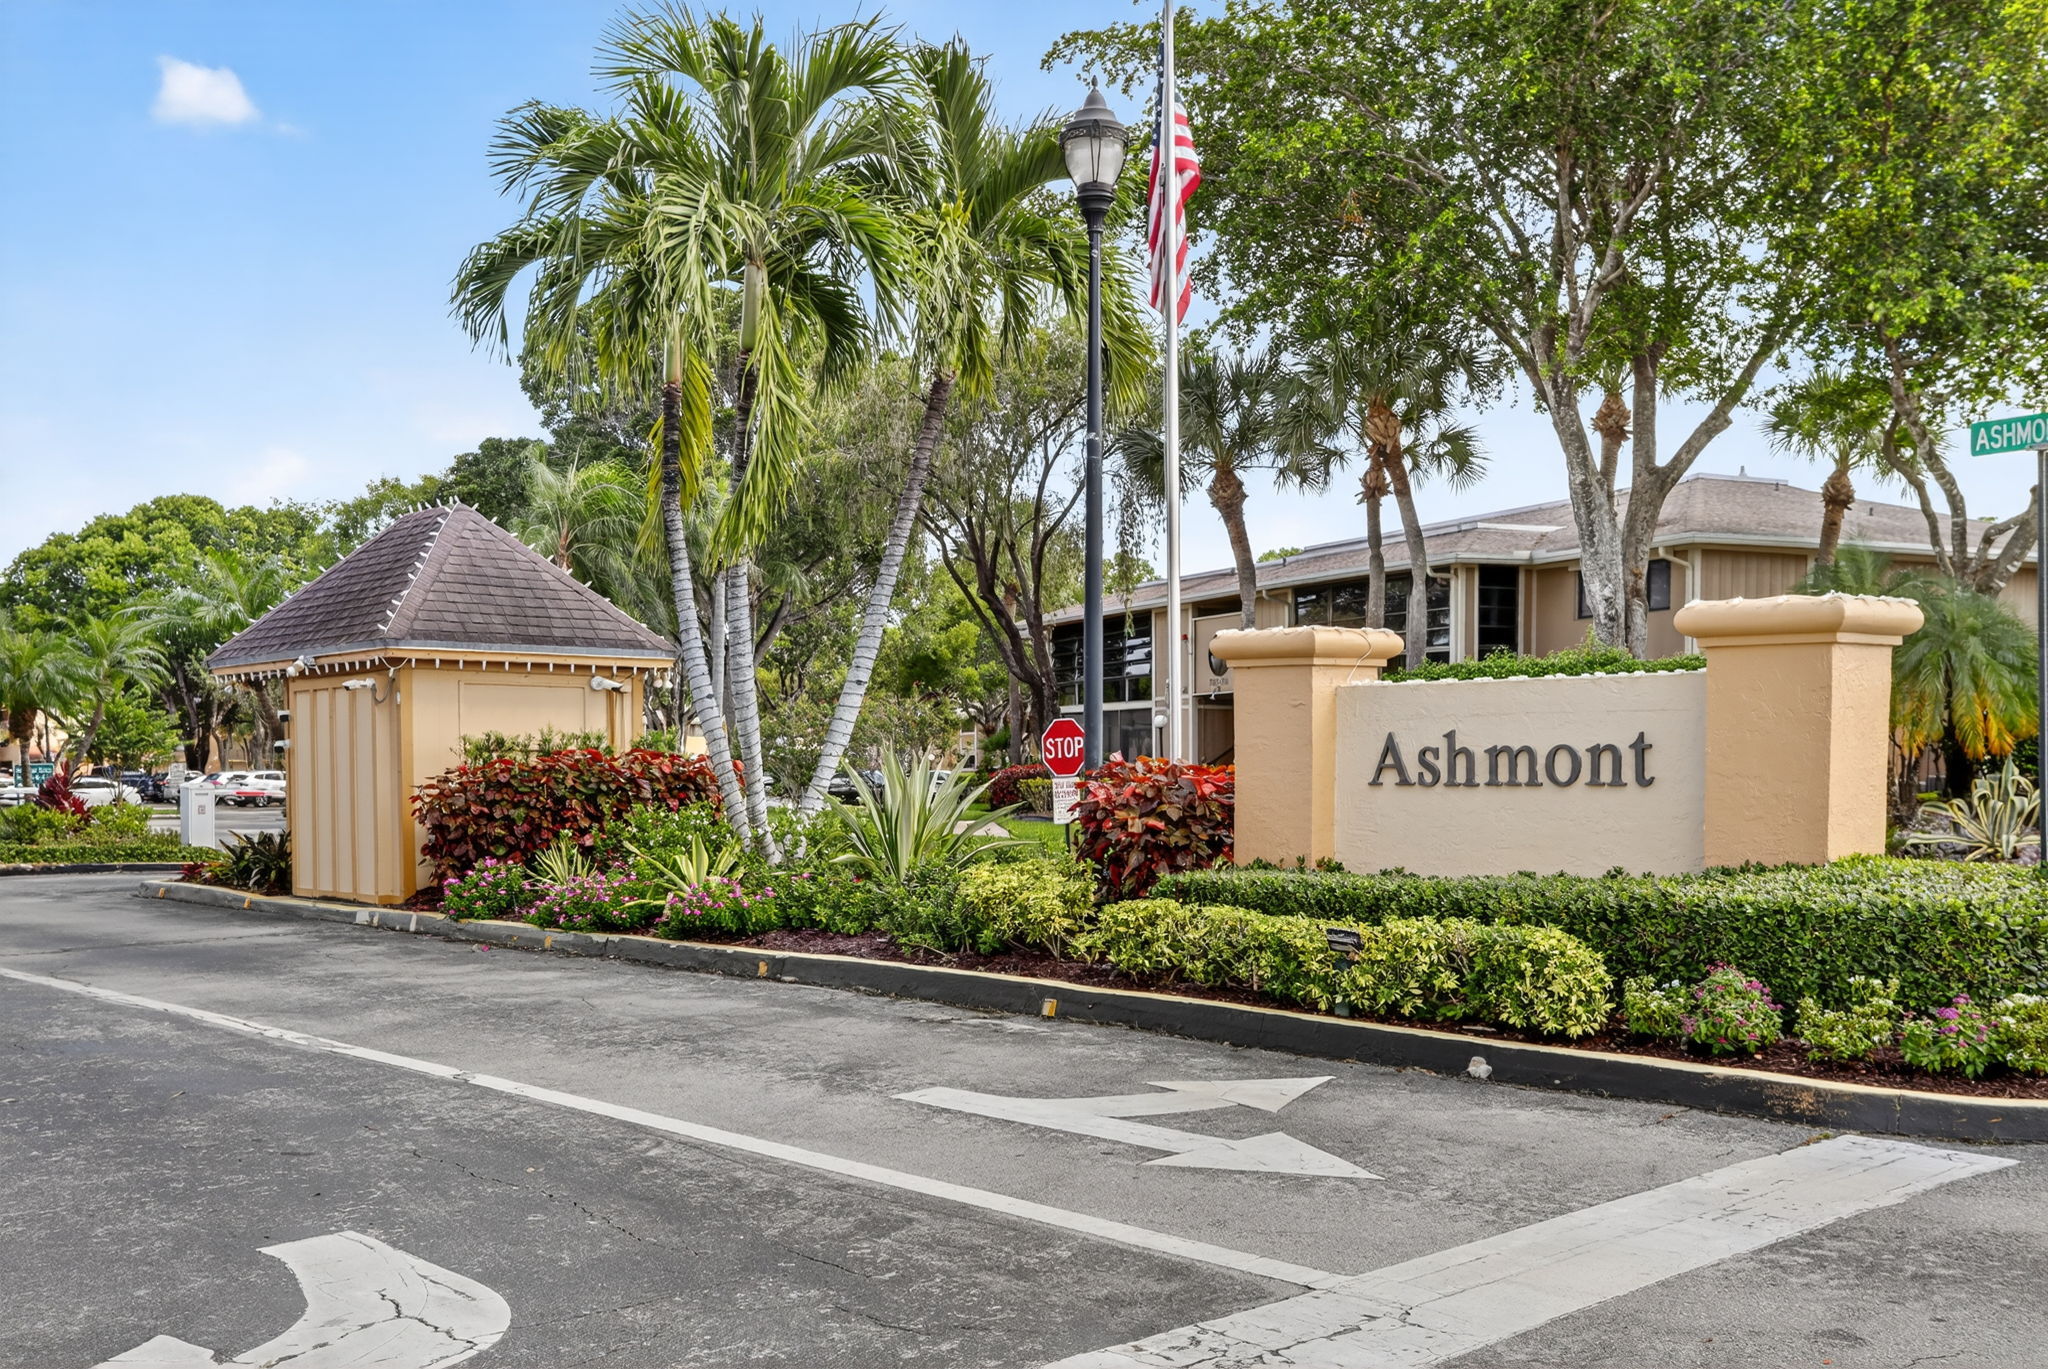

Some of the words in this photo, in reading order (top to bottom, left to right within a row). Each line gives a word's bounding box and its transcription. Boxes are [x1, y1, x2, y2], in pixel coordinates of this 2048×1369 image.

[1975, 418, 2048, 452] ASHMO
[1045, 737, 1084, 759] STOP
[1367, 729, 1655, 787] Ashmont
